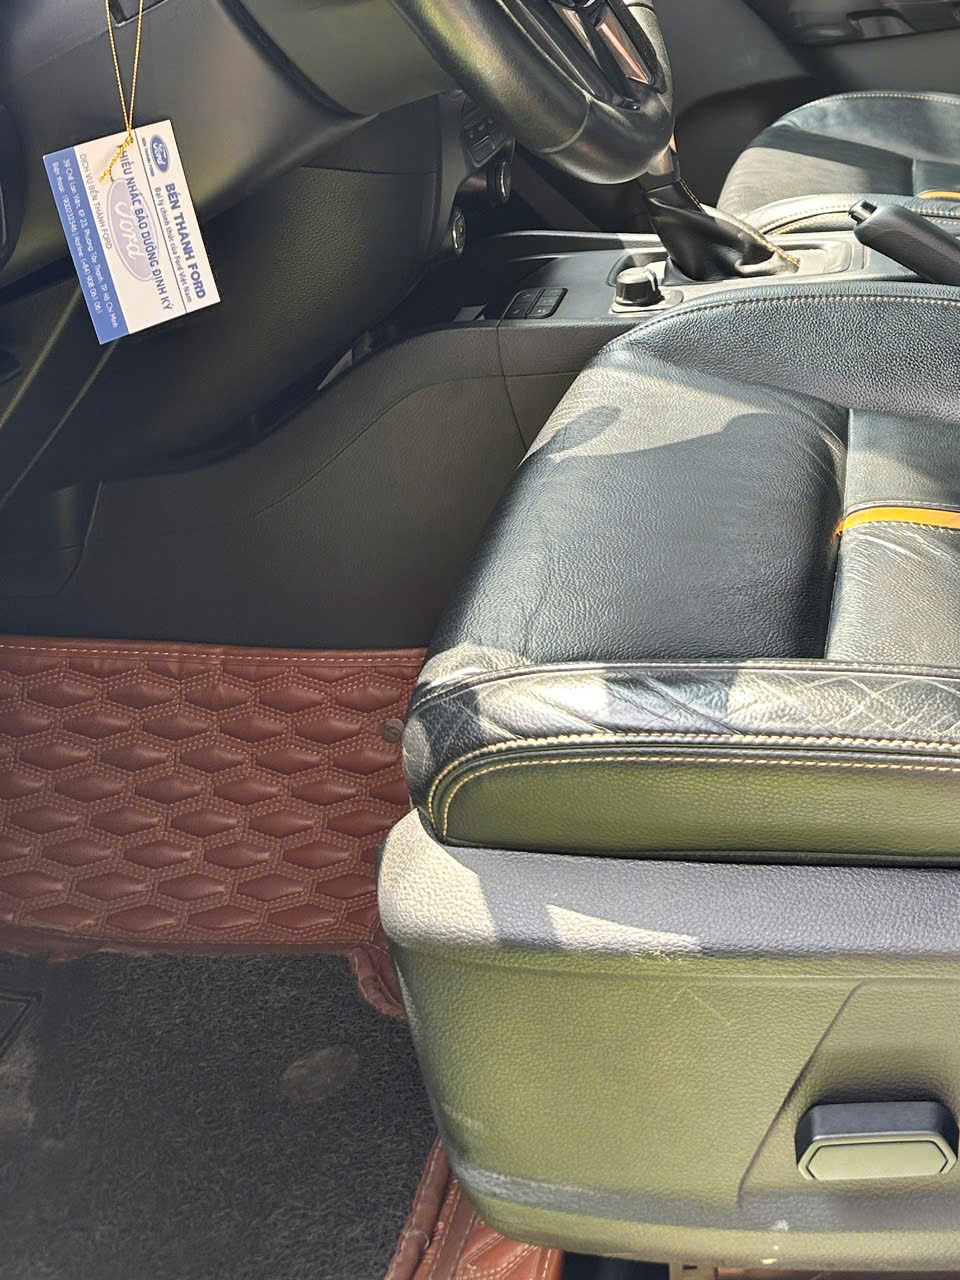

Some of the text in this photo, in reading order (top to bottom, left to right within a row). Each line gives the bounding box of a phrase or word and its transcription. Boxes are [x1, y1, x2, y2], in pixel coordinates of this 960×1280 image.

[152, 141, 170, 167] Ford
[101, 228, 113, 250] FORD
[134, 207, 151, 230] BẢO
[149, 268, 167, 297] ĐỊNH
[165, 182, 207, 300] BẾN THÀNH FORD
[174, 255, 184, 271] Ford
[183, 286, 193, 303] Nam
[108, 313, 119, 329] Minh
